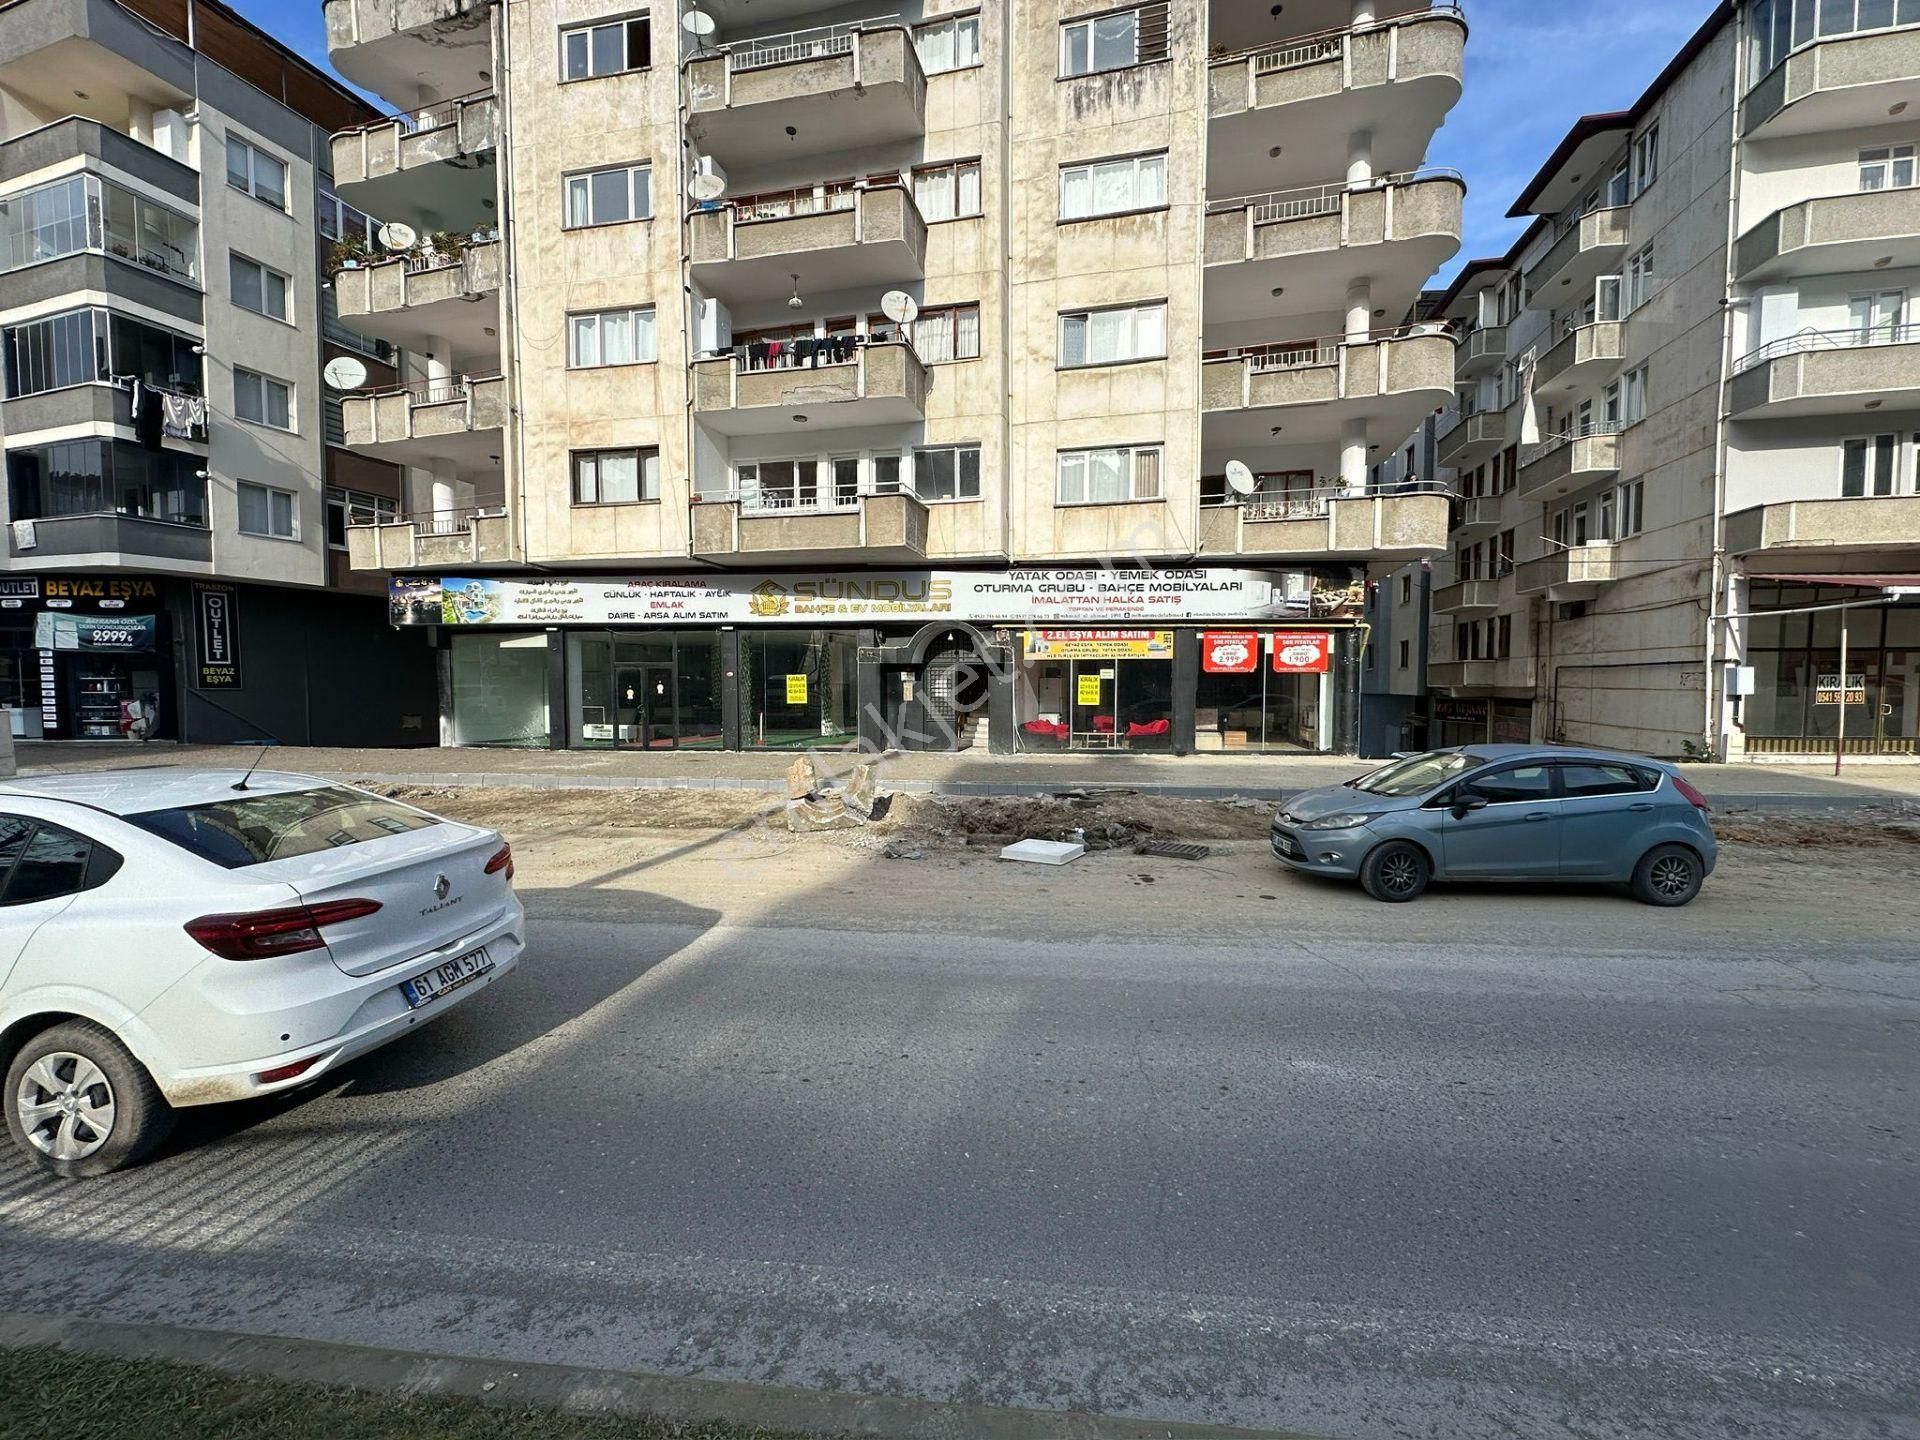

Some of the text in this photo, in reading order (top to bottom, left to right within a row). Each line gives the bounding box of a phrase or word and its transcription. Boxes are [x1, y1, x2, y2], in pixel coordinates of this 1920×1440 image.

[1008, 571, 1050, 580] YATAK
[1055, 571, 1097, 580] ODASI
[1110, 570, 1159, 580] YEMEK
[1164, 570, 1207, 579] ODASI
[0, 582, 36, 593] UTLET
[46, 580, 156, 600] BEYAZ EŞYA
[628, 579, 707, 590] ARAÇ KİRALAMA
[973, 583, 1034, 593] OTURMA
[1038, 583, 1085, 593] GRUBU
[1098, 583, 1145, 595] BAHÇE
[1148, 580, 1243, 592] MOBİLYALARI
[603, 589, 641, 598] GÜNLÜK
[650, 590, 696, 598] HAFTALIK
[705, 589, 732, 598] AYLIK
[650, 601, 685, 609] EMLAK
[1031, 595, 1182, 605] İMALATTAN HALKA SATIŞ
[795, 602, 952, 615] BAHÇE & EV MOBİLYALARI
[607, 610, 636, 619] DAİRE
[643, 611, 670, 619] ARSA
[673, 611, 697, 619] ALIM
[700, 611, 729, 619] SATIM
[208, 597, 223, 659] OUTLET
[1047, 630, 1149, 641] 2.EL EŞYA ALIM SATIM
[203, 667, 236, 675] BEYAZ
[206, 675, 232, 684] EŞYA
[420, 896, 463, 916] TALIANT
[414, 976, 434, 996] 61
[436, 961, 464, 987] AGM
[462, 949, 486, 973] 577
